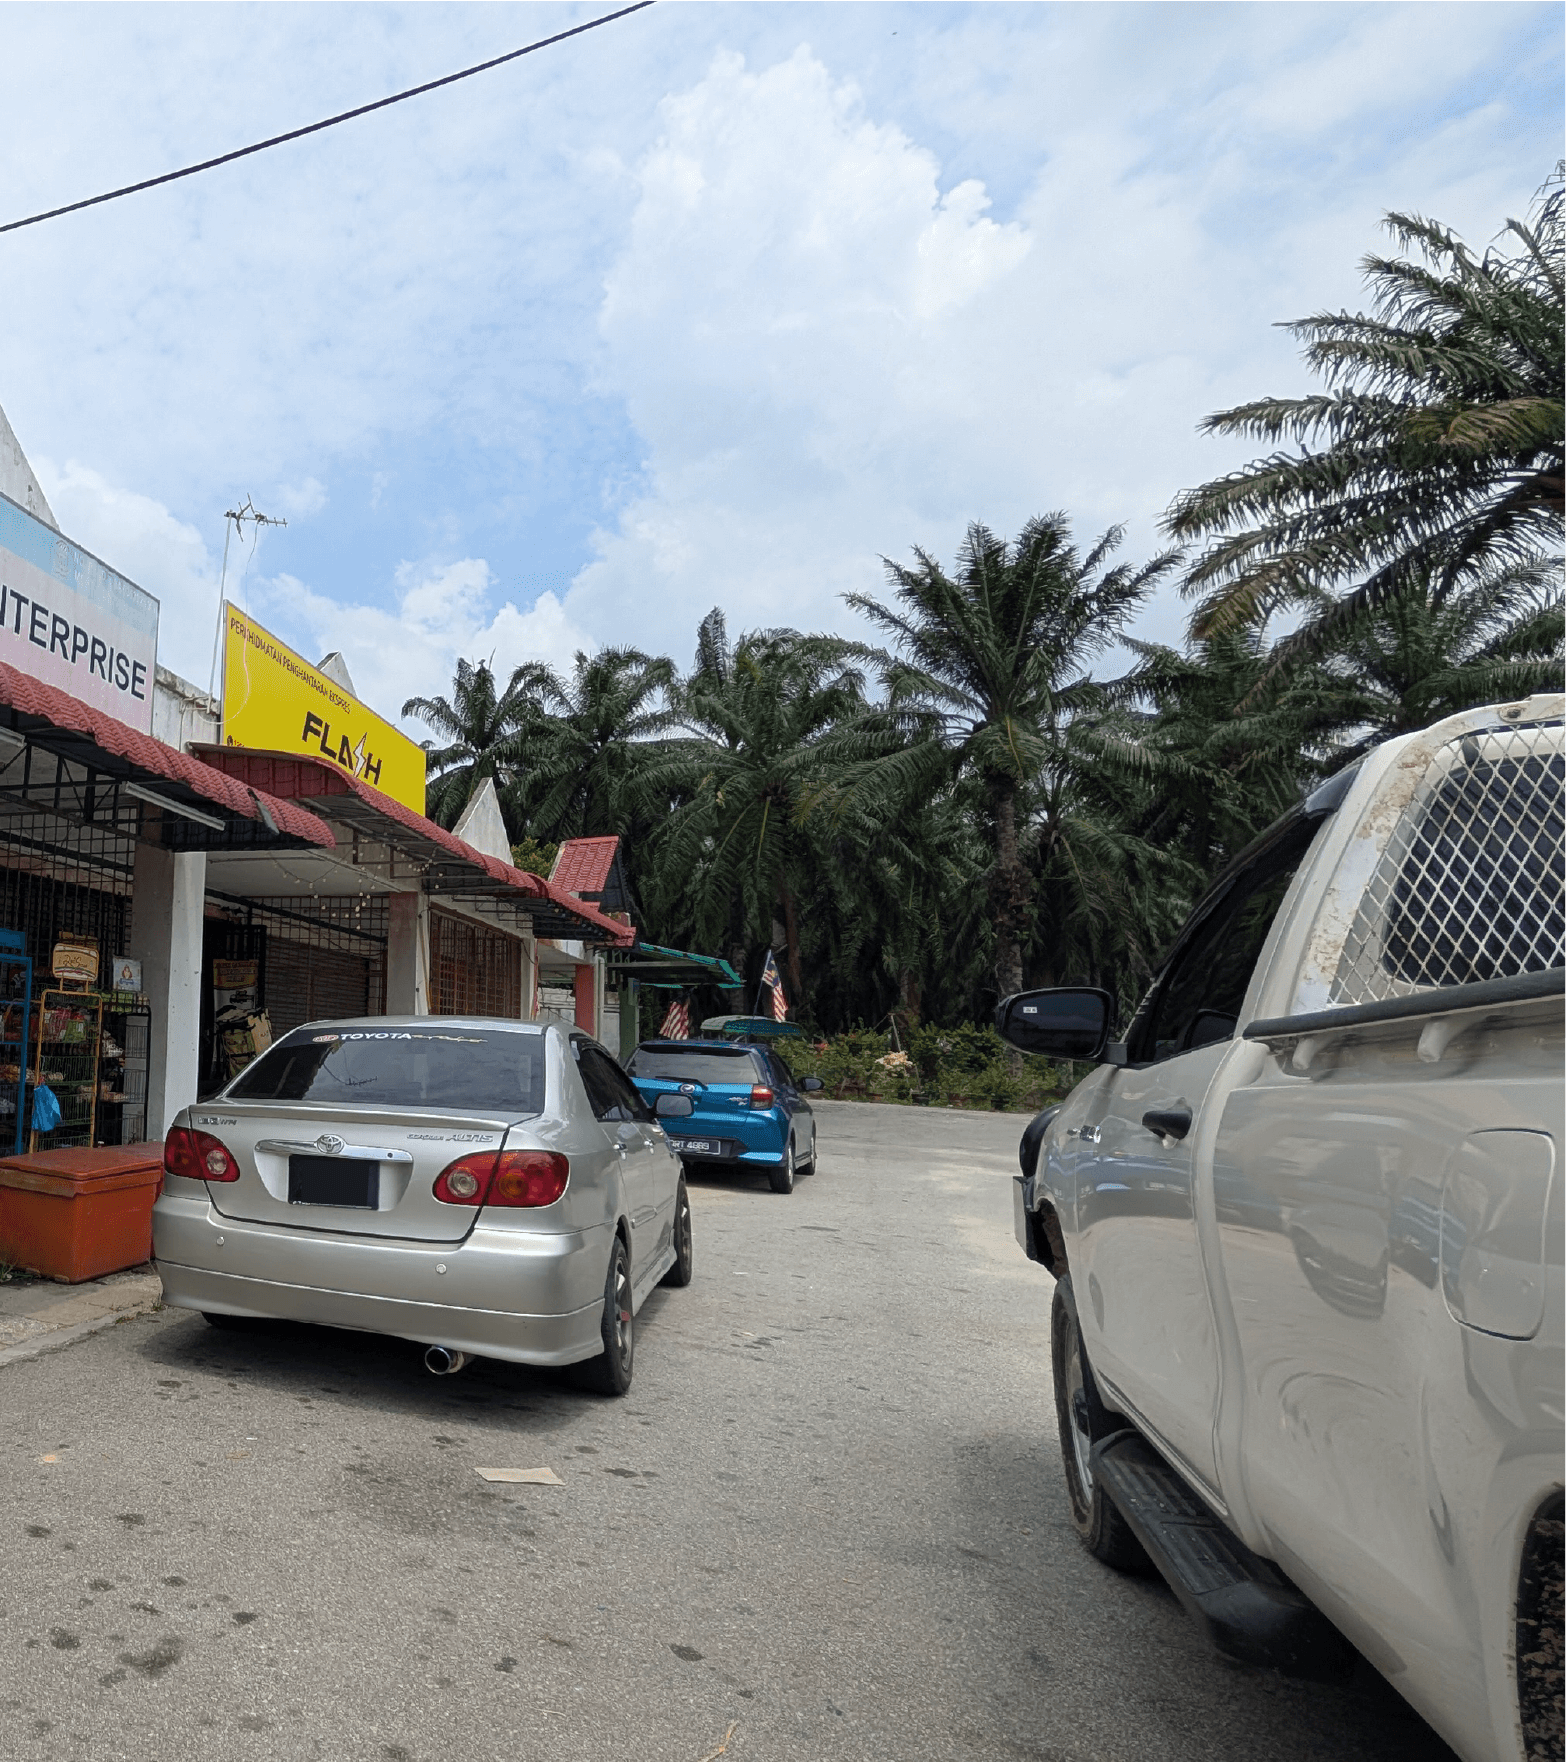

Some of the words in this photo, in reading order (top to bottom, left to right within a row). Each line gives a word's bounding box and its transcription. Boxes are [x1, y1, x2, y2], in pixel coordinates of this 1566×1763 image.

[230, 617, 283, 665] PERKHIDMATAN
[282, 655, 329, 697] PENGHANTARAN
[302, 711, 382, 785] FLASH
[340, 1032, 413, 1041] TOYOTA
[444, 1133, 490, 1143] ALTIS
